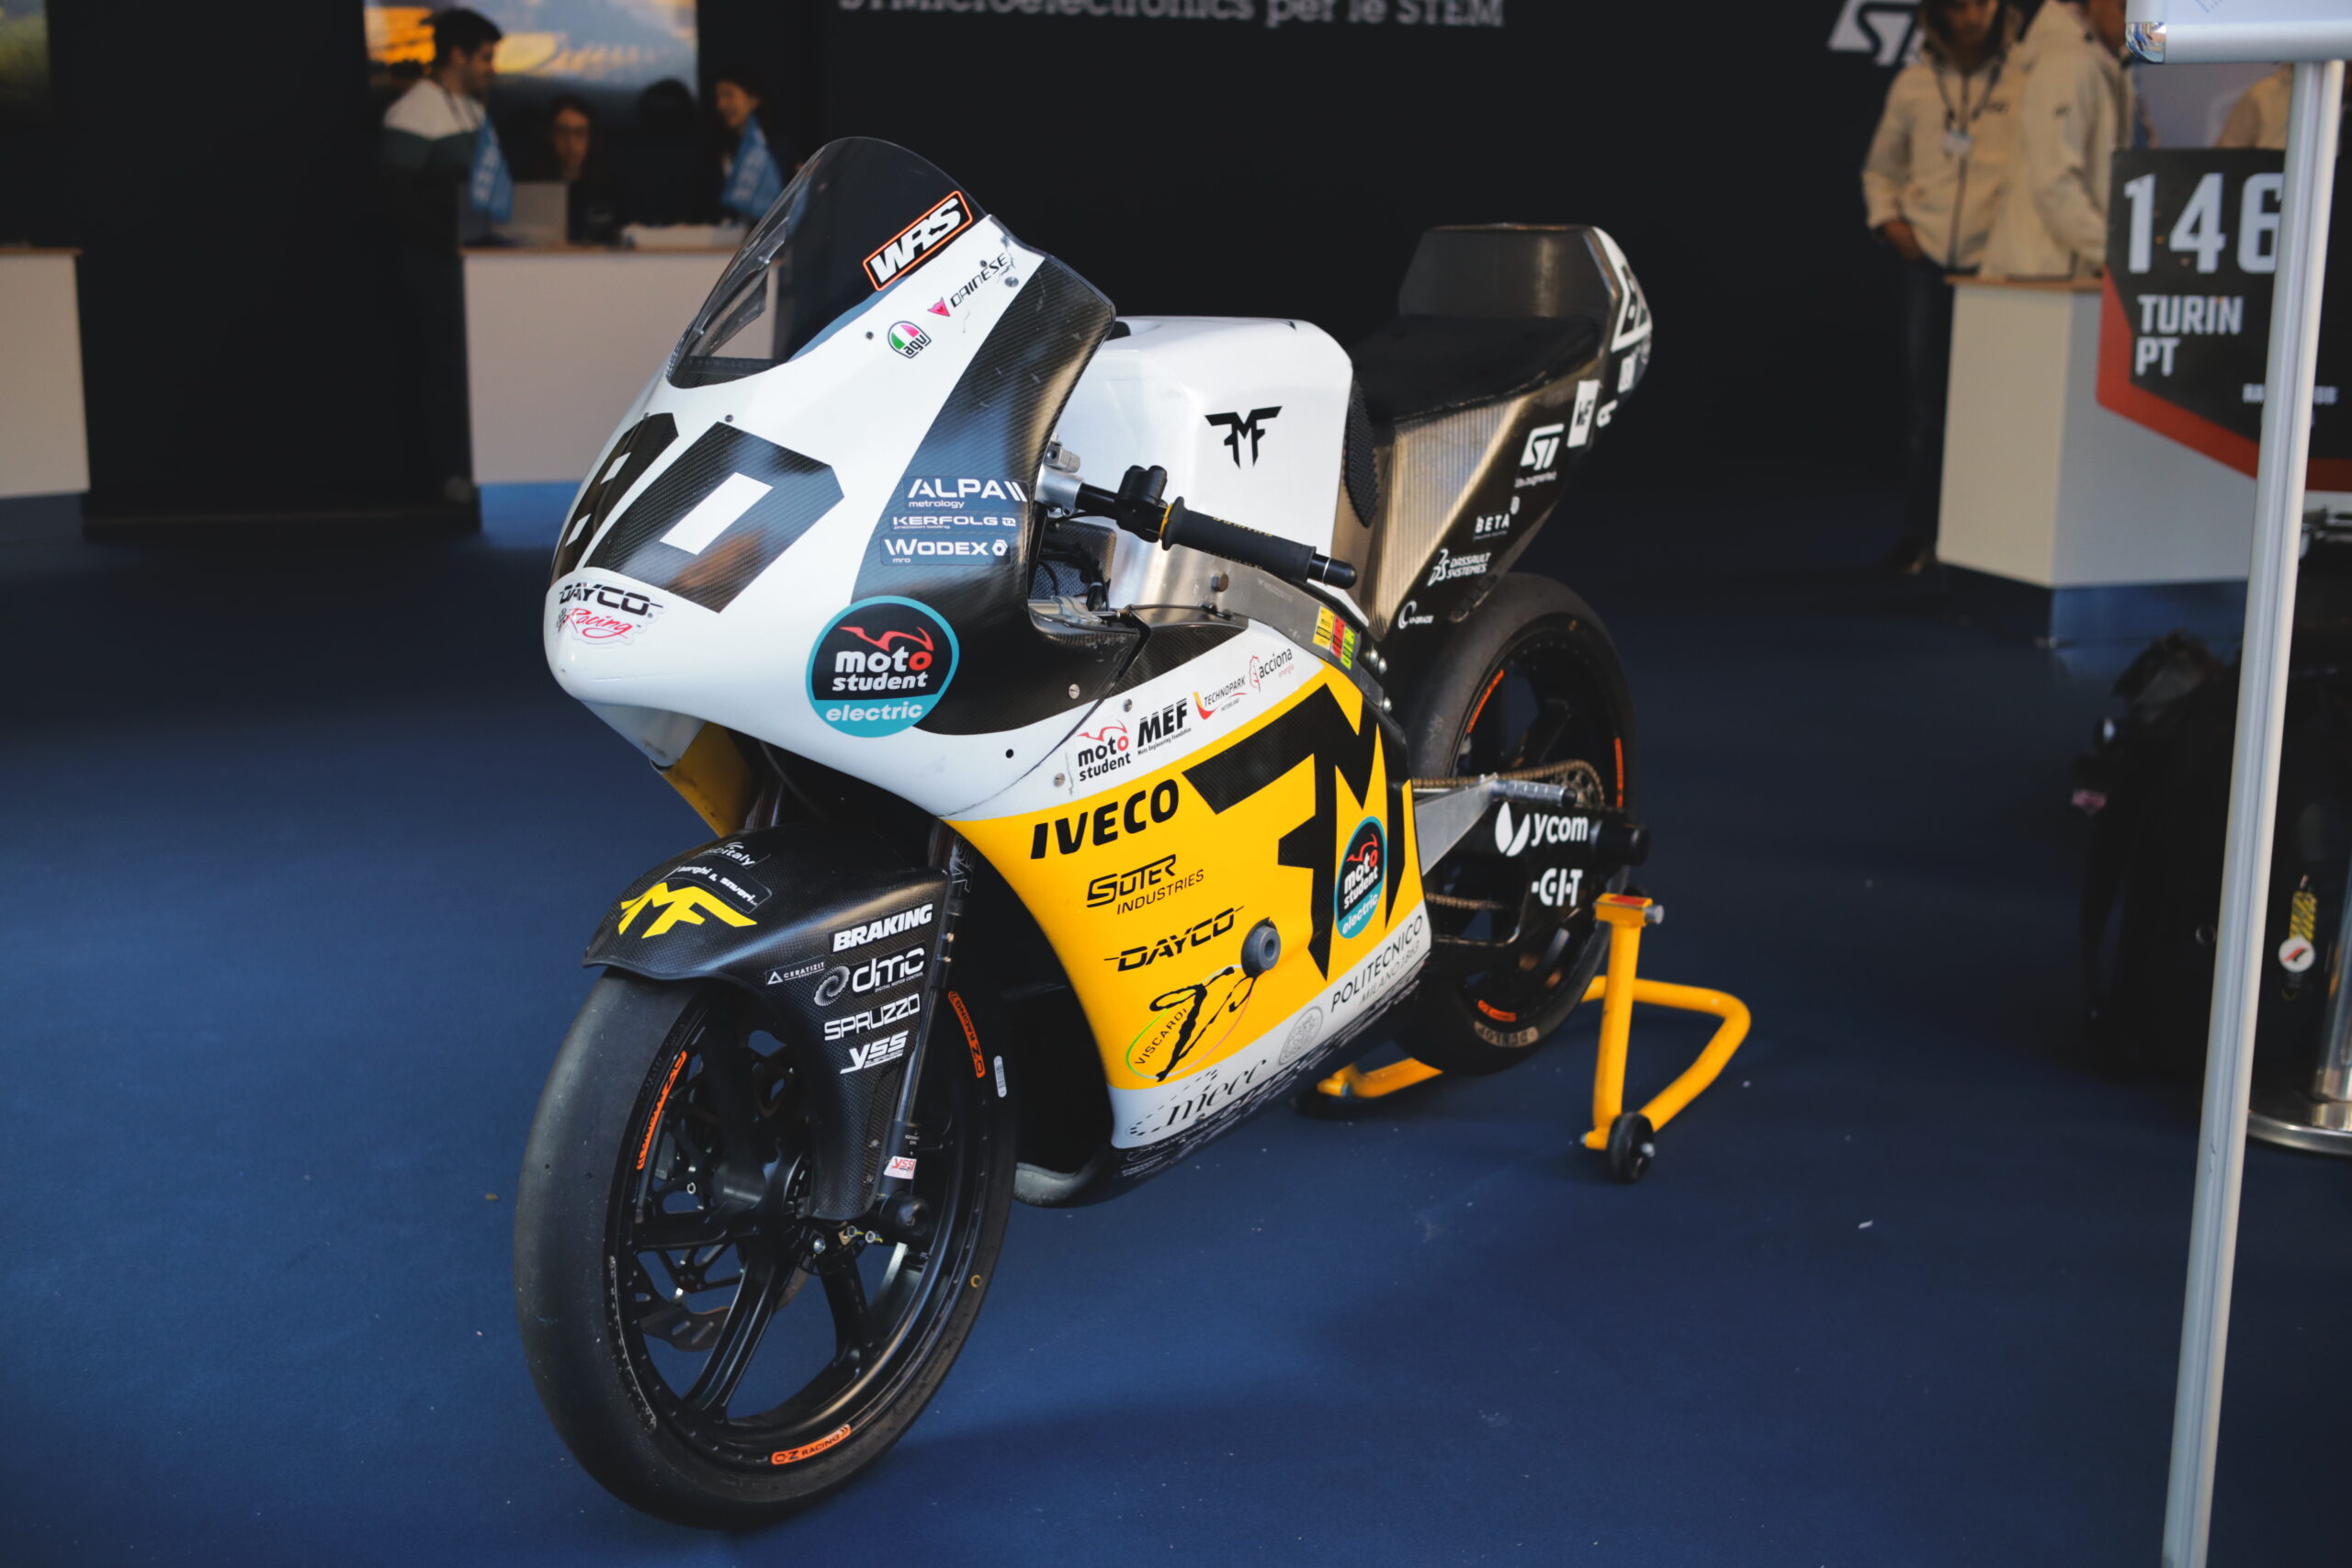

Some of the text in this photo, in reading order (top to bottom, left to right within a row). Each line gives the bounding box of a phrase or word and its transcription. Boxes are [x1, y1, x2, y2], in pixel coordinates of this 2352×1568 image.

[869, 197, 962, 285] WRS
[950, 253, 1008, 308] DAINESE
[2137, 294, 2244, 334] TURIN
[2135, 336, 2180, 376] PT
[892, 516, 999, 526] KERFOLG
[908, 500, 965, 509] metrology
[1475, 513, 1510, 534] BETA
[834, 646, 933, 673] moto
[1259, 648, 1294, 679] acciona
[831, 671, 928, 691] student
[1204, 675, 1246, 706] TECHNOPARK
[826, 701, 923, 722] electric
[1137, 698, 1188, 749] MEF
[1078, 736, 1129, 768] moto
[1080, 751, 1132, 782] student
[1030, 779, 1180, 860] IVECO
[1532, 813, 1589, 847] ycom
[1086, 853, 1177, 908] SUTER
[1343, 866, 1379, 910] student
[1344, 849, 1378, 895] moto
[1117, 869, 1205, 916] INDUSTRIES
[832, 903, 933, 953] BRAKING
[1342, 893, 1379, 935] electric
[1108, 906, 1242, 973] DAYCO
[784, 962, 825, 979] CERATIZIT
[1330, 915, 1423, 1013] POLITECNICO
[824, 992, 921, 1041] SPRUZZO
[1134, 1007, 1188, 1066] VISCARDI
[801, 1434, 841, 1456] RACING
